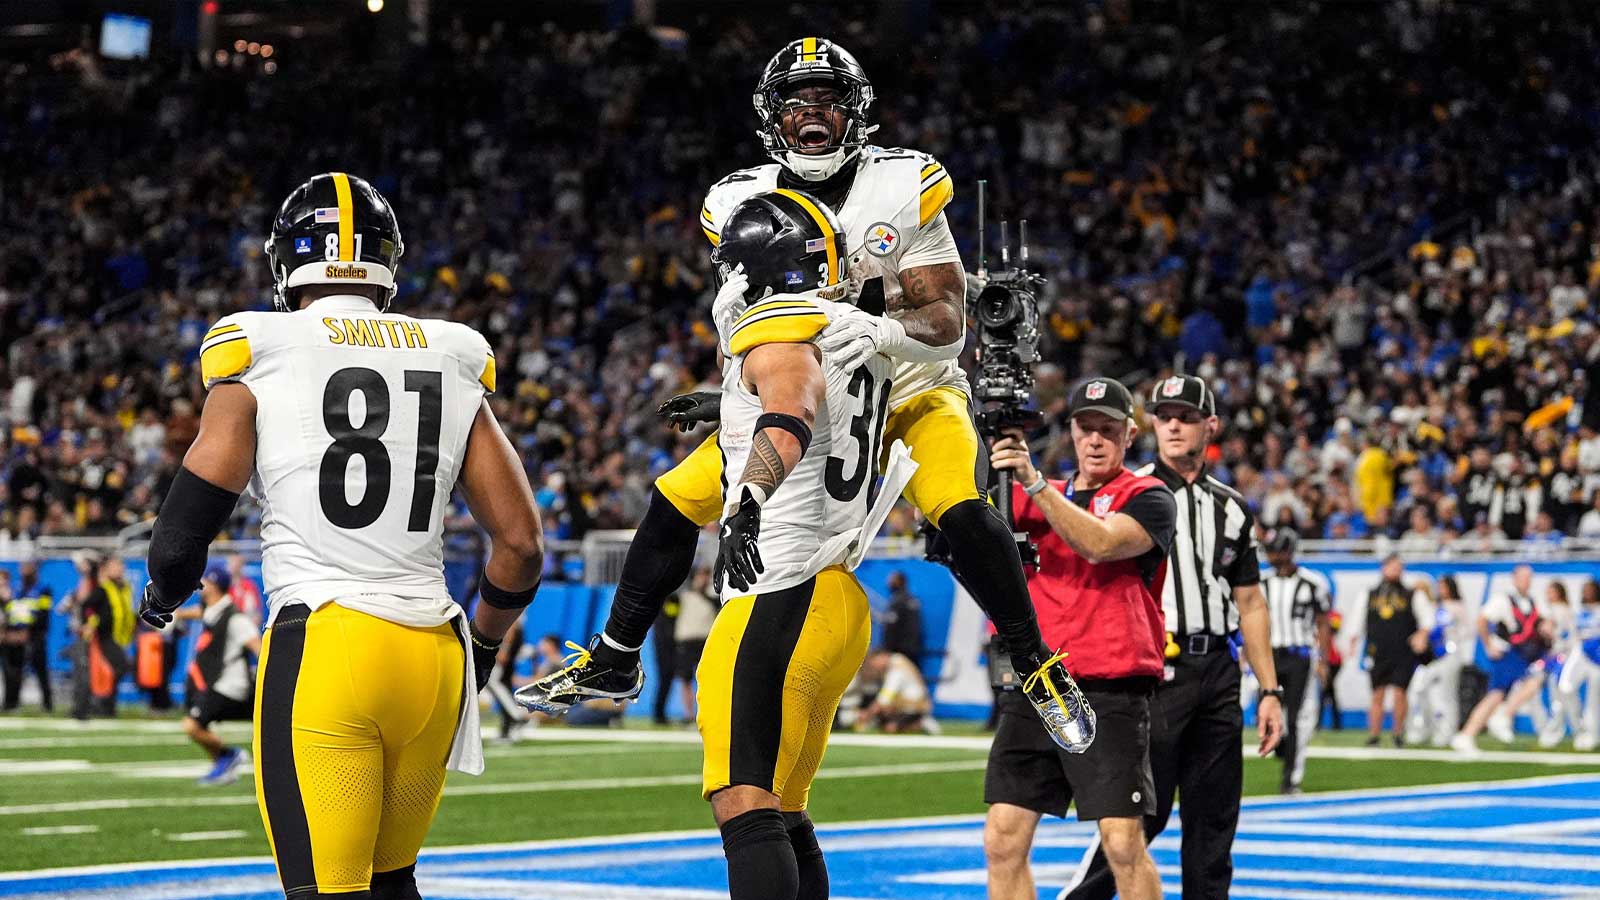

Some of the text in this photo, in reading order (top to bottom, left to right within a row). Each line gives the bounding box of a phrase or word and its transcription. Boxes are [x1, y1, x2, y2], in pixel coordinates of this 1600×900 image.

[325, 232, 362, 262] 81
[325, 264, 368, 279] Steelers
[322, 316, 428, 349] SMITH
[318, 366, 443, 532] 81
